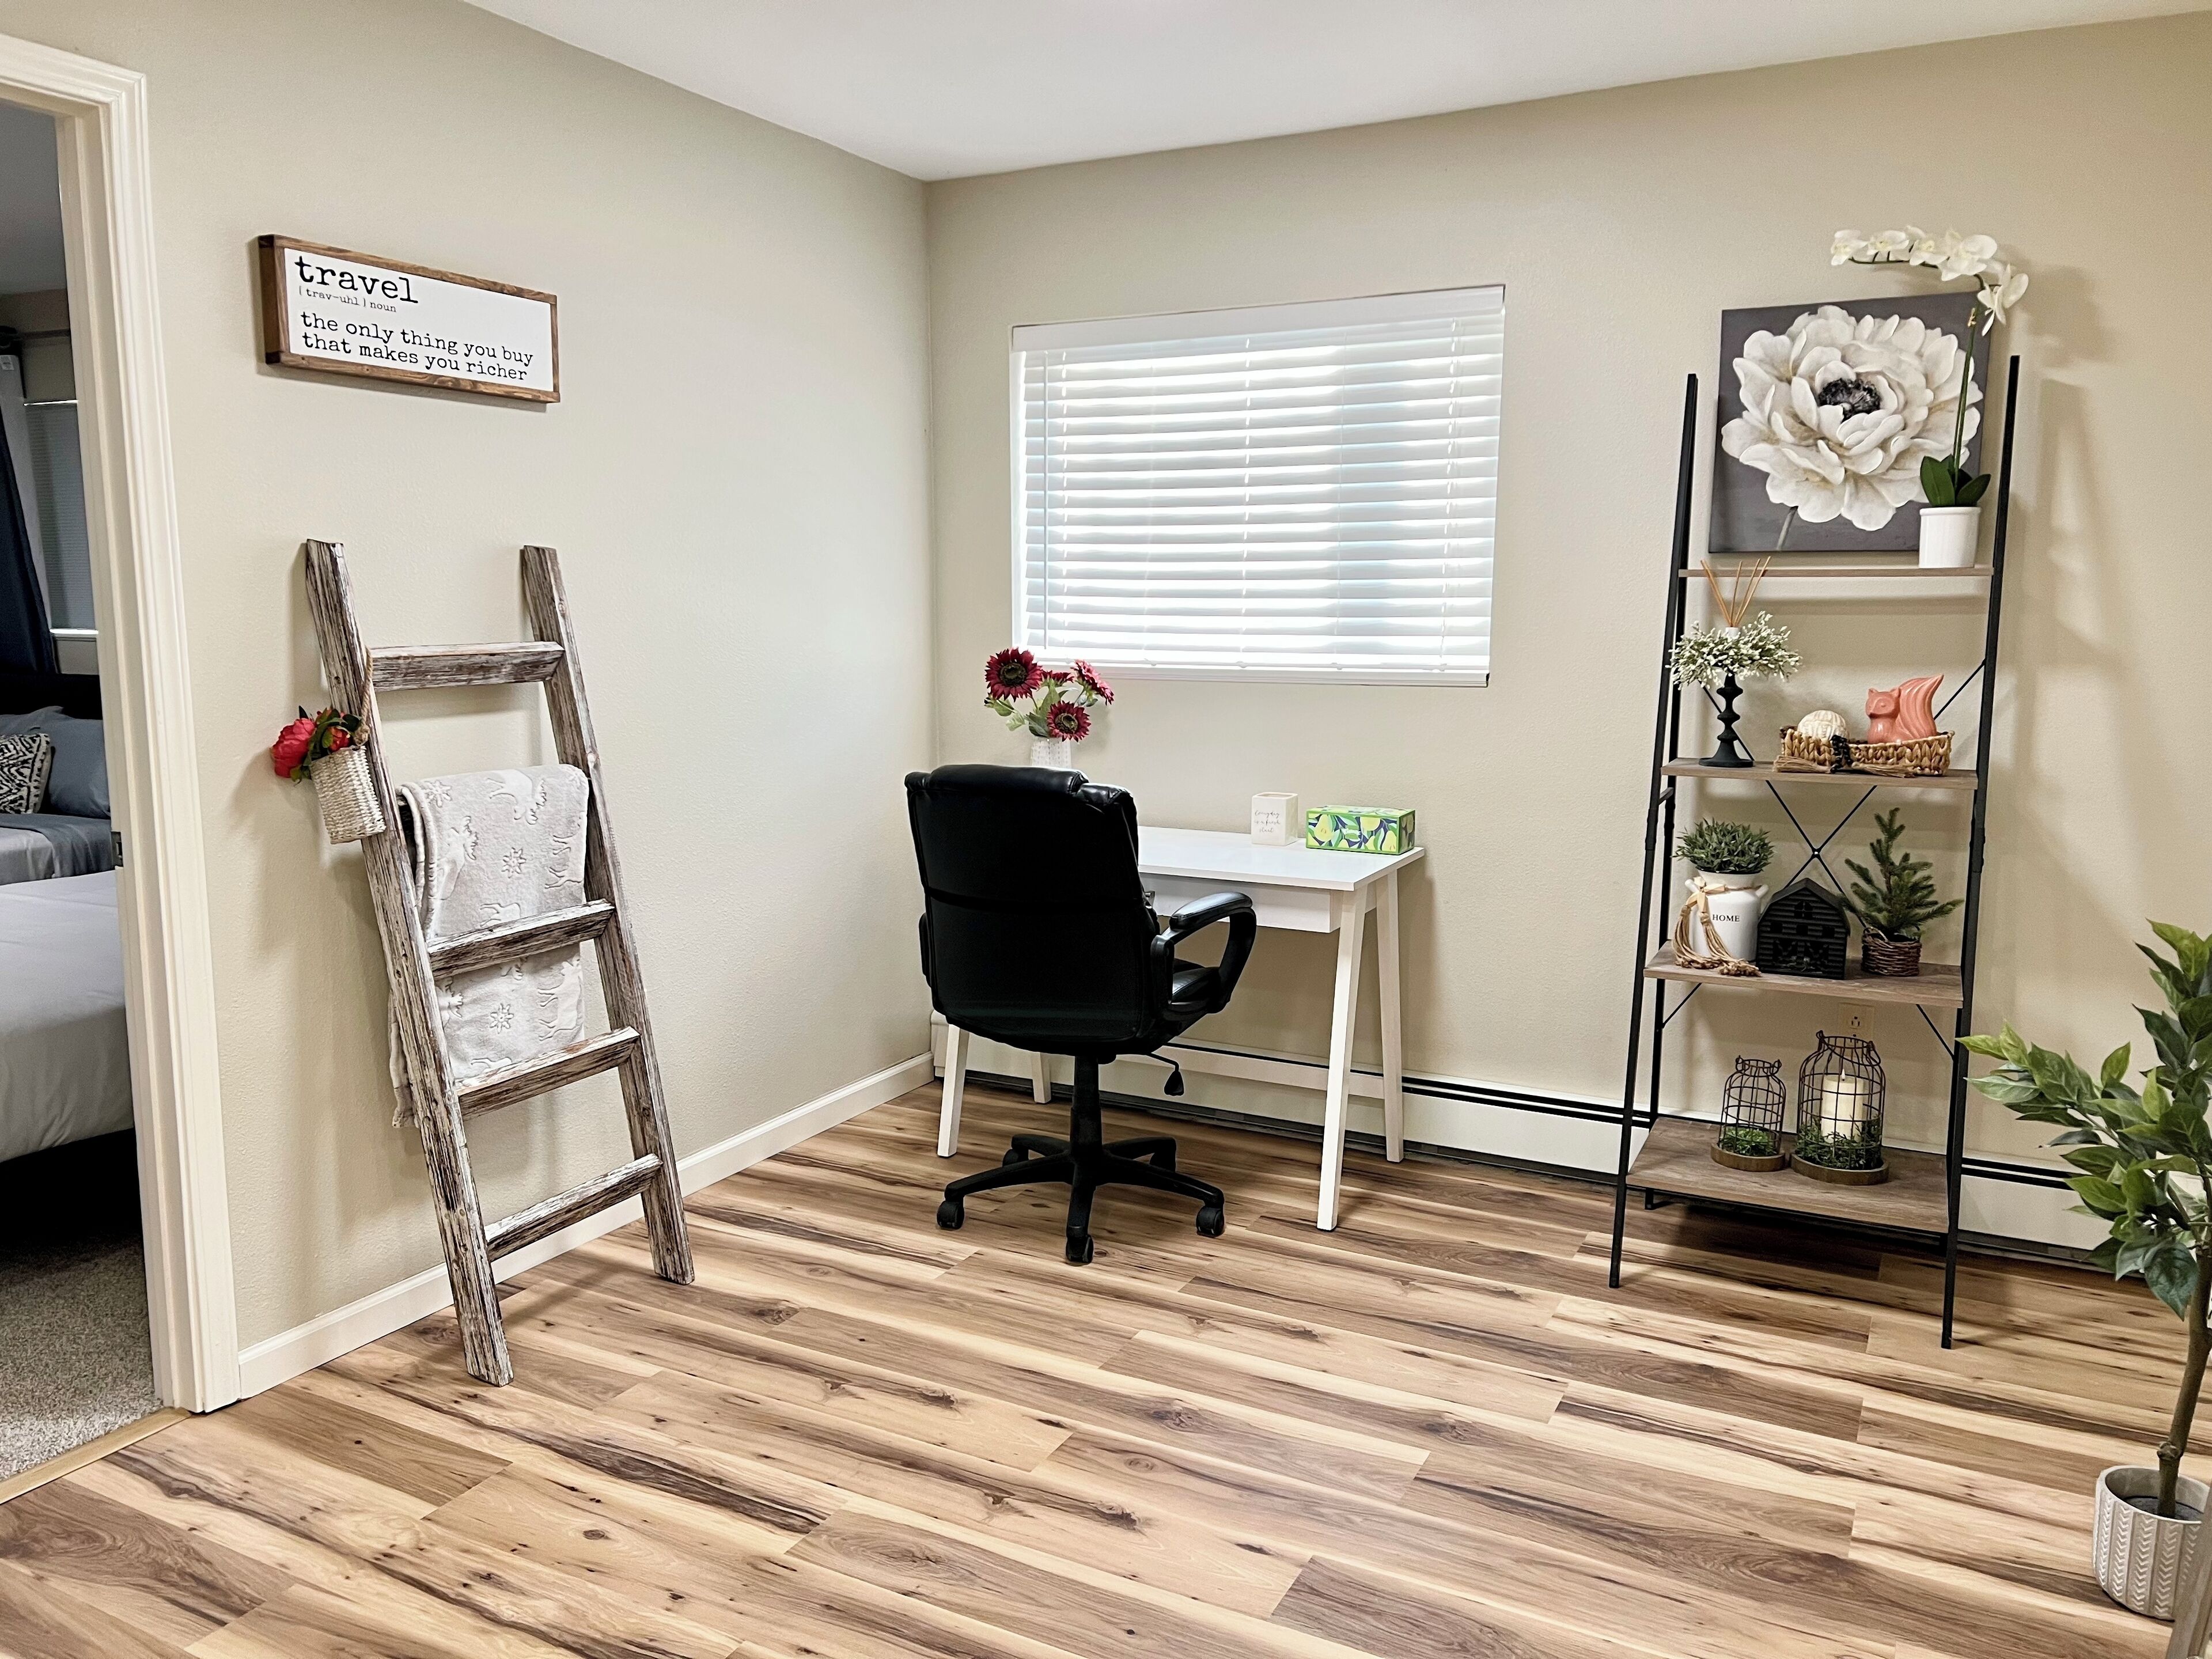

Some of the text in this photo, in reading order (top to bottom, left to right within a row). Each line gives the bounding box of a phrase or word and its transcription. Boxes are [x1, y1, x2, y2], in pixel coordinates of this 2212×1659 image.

[294, 255, 419, 304] travel
[370, 301, 397, 313] noun
[300, 312, 534, 367] the only thing you buy
[302, 332, 528, 380] that makes you richer
[1712, 914, 1740, 922] HOME
